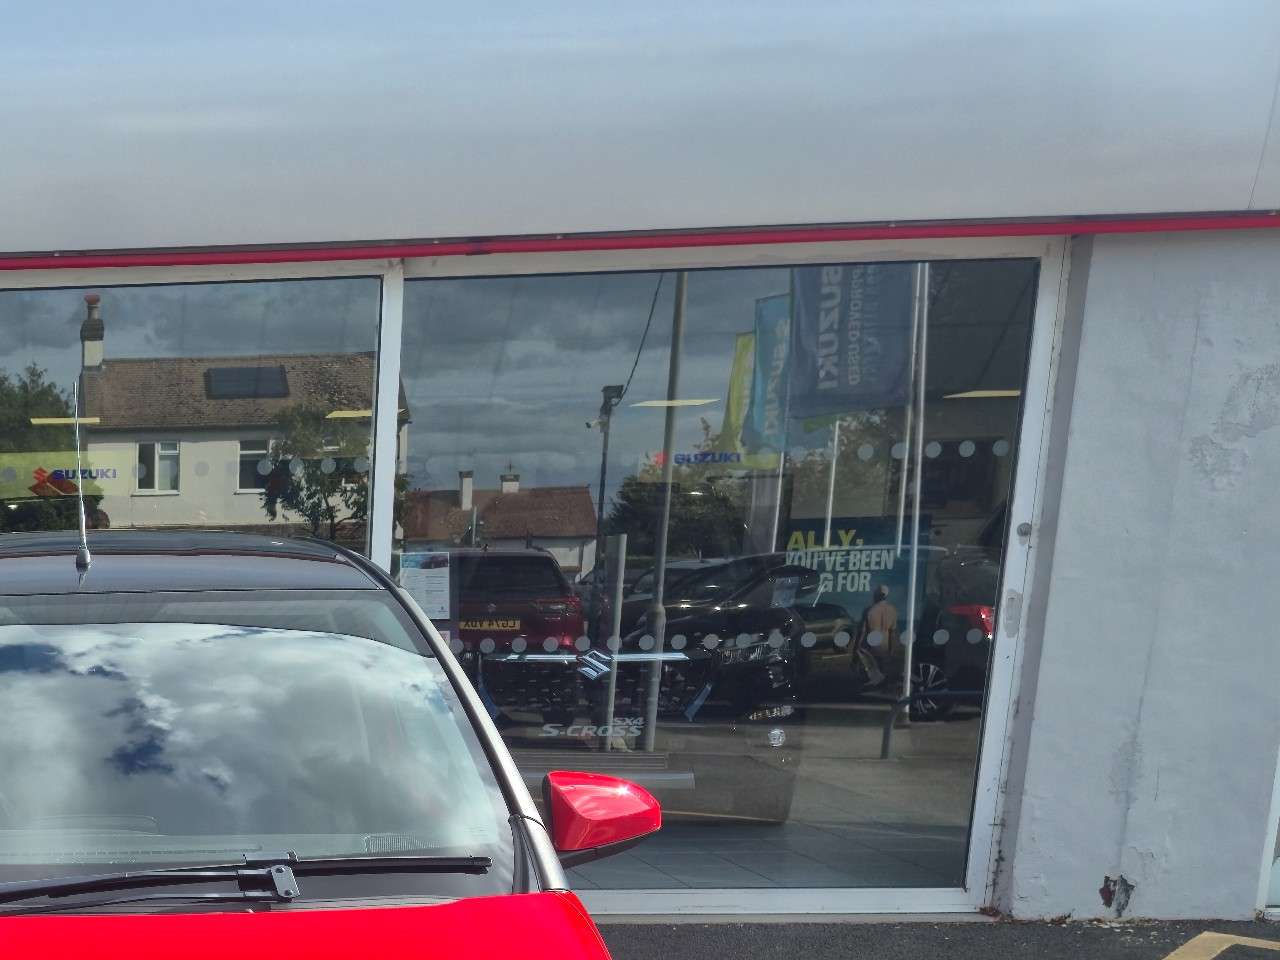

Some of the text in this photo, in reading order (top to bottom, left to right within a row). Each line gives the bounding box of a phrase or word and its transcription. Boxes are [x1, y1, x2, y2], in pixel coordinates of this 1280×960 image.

[673, 452, 740, 464] SUZUKI
[53, 468, 117, 479] SUZUKI
[848, 549, 895, 570] BEEN
[835, 572, 872, 592] FOR
[613, 717, 645, 726] SX4
[539, 723, 645, 737] S-CROSS
